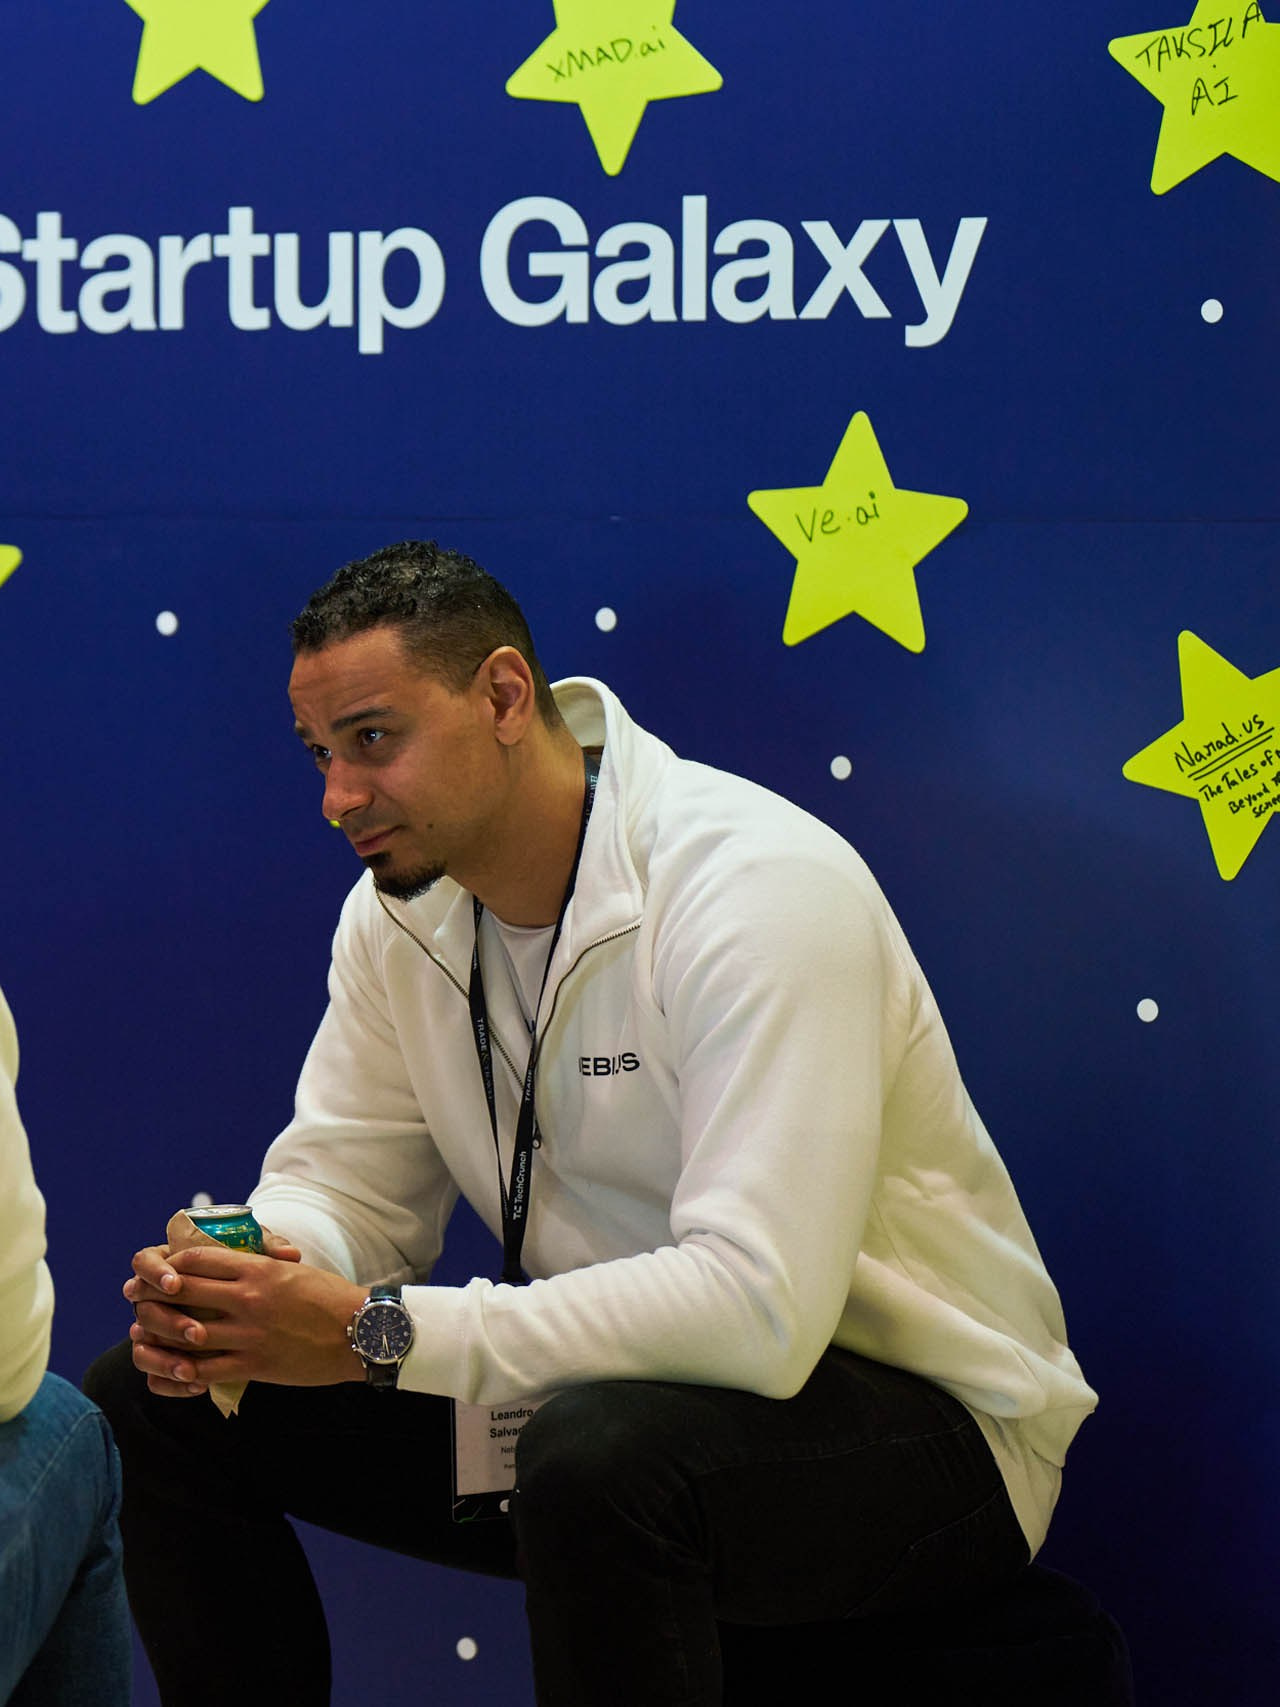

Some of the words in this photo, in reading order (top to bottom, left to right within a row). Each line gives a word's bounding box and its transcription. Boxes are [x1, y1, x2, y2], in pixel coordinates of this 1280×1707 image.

[546, 24, 666, 83] xMAD.ai
[1135, 2, 1261, 72] TAKSILA
[1191, 76, 1239, 116] AI
[480, 195, 988, 347] Galaxy
[1174, 714, 1265, 773] Narad.us
[1199, 784, 1224, 801] The
[1221, 763, 1259, 790] Tales
[1260, 749, 1274, 766] of
[476, 1018, 487, 1051] TRADE
[514, 1151, 527, 1205] TechCrunch
[491, 1408, 534, 1421] Leandro
